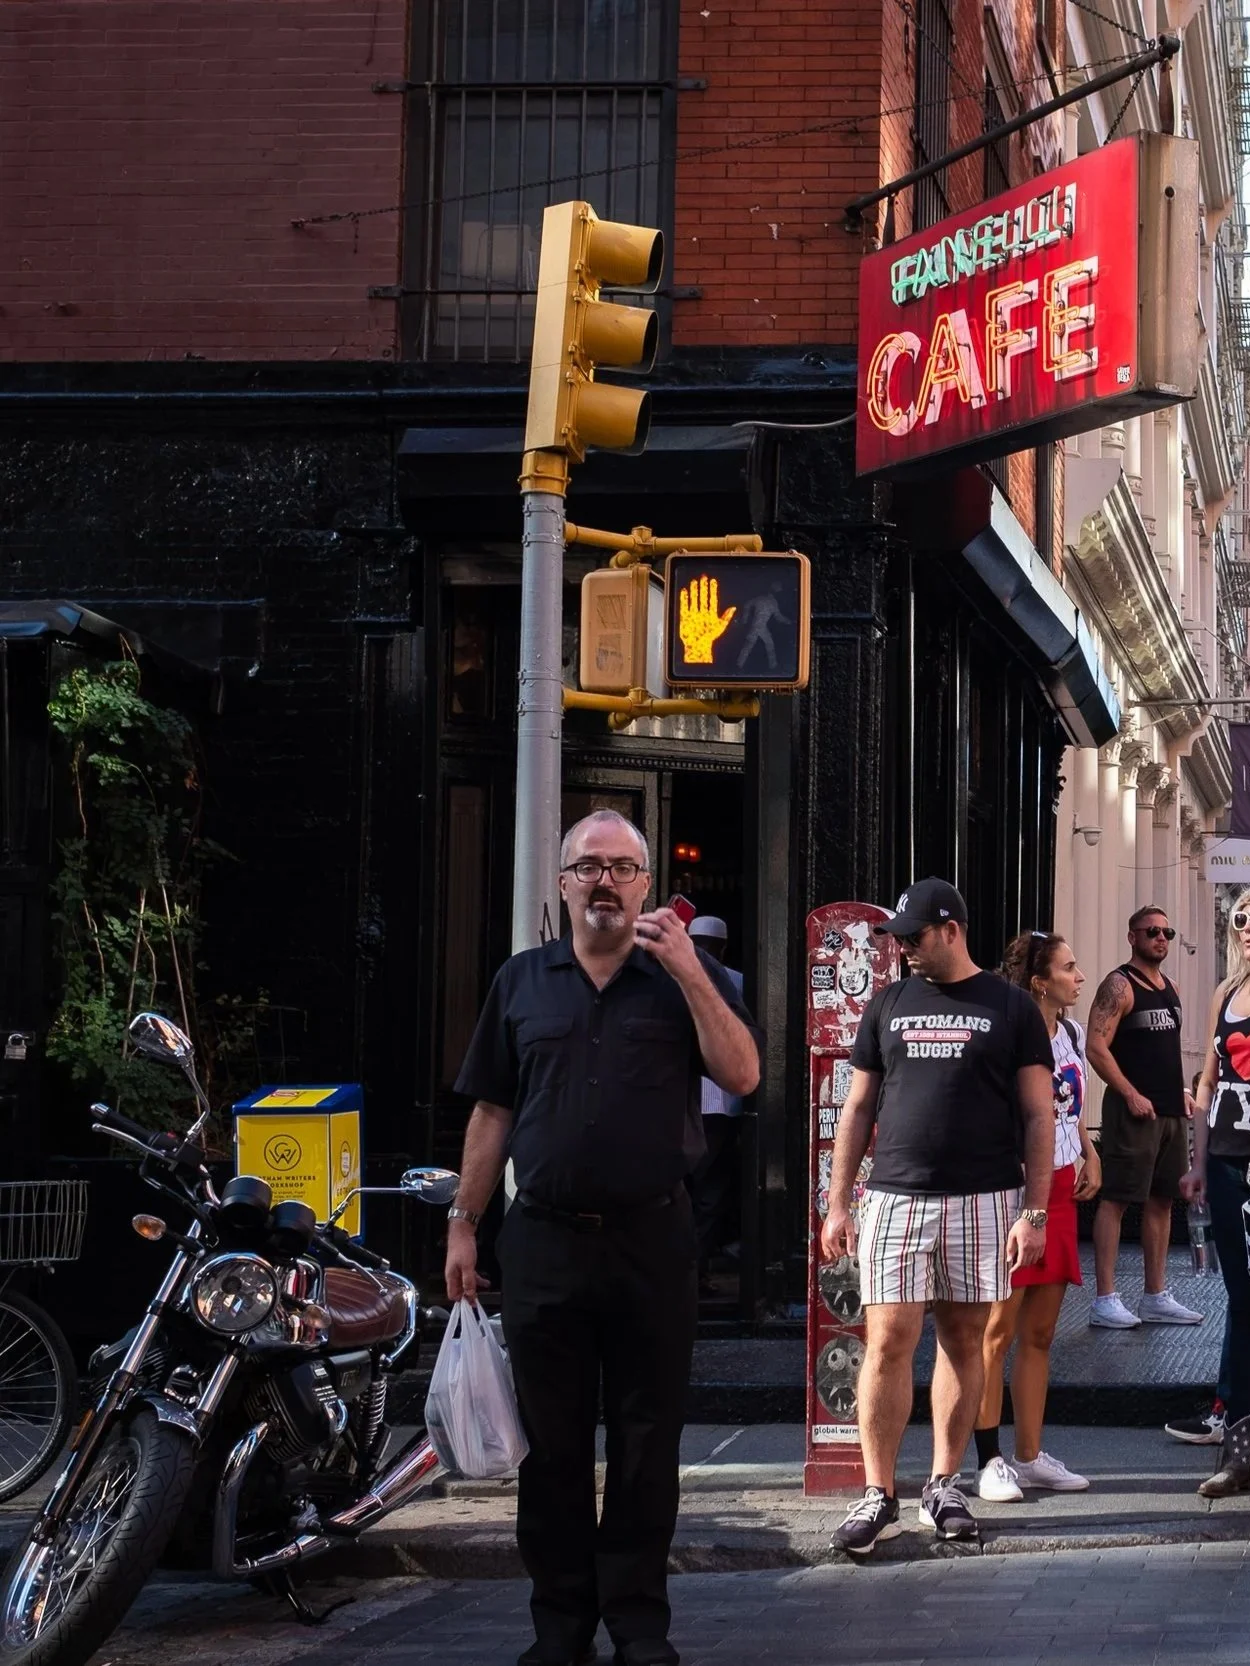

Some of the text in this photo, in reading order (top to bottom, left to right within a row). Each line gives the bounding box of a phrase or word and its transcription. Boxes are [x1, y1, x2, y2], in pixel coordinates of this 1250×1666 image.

[867, 256, 1099, 437] CAFE
[889, 1014, 992, 1032] OTTOMANS
[1150, 1010, 1174, 1026] BOS
[906, 1042, 965, 1058] RUGBY
[818, 1107, 836, 1123] PERU
[819, 1123, 834, 1139] ANA
[814, 1426, 838, 1436] global
